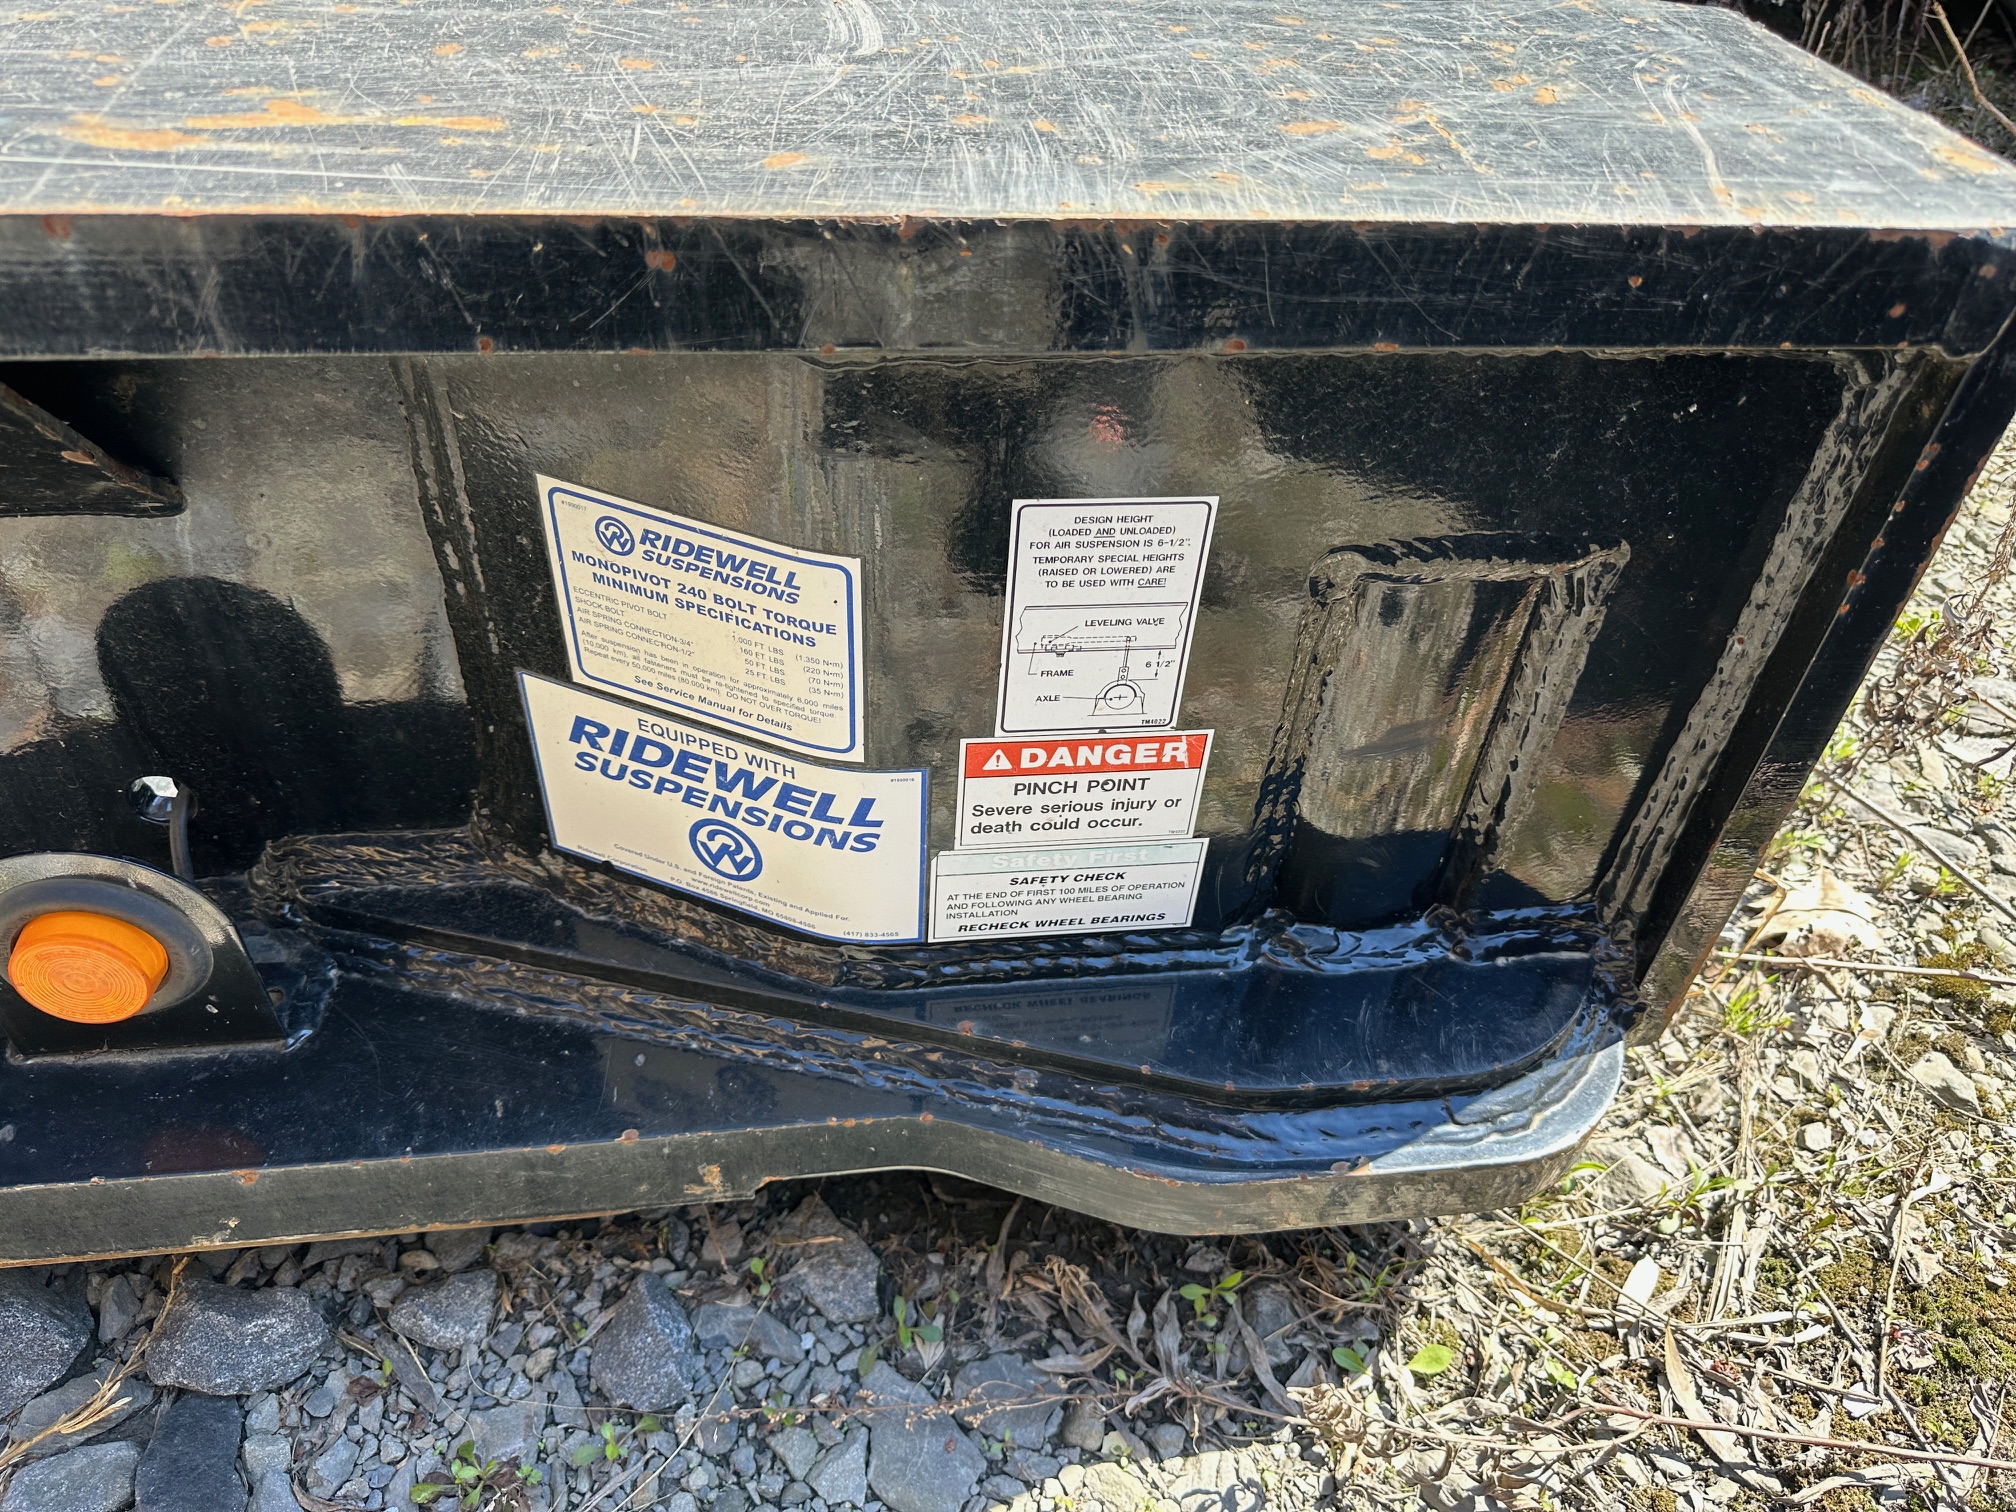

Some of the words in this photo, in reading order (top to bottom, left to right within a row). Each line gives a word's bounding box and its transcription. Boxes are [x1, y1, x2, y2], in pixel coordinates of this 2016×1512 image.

[1074, 516, 1113, 524] DESIGN
[1117, 515, 1153, 523] HEIGHT
[1049, 528, 1091, 537] (LOADED
[1095, 528, 1115, 536] AND
[1120, 527, 1175, 535] UNLOADED)
[1054, 541, 1071, 549] AIR
[1075, 539, 1139, 548] SUSPENSION
[1143, 539, 1153, 547] IS
[639, 528, 801, 591] RIDEWELL
[1033, 556, 1094, 564] TEMPORARY
[1098, 555, 1138, 563] SPECIAL
[1143, 553, 1184, 561] HEIGHTS
[641, 549, 800, 604] SUSPENSIONS
[1038, 568, 1078, 576] (RAISED
[1101, 566, 1152, 575] LOWERED)
[572, 550, 671, 589] MONOPIVOT
[677, 582, 706, 600] 240
[713, 592, 757, 616] BOLT
[762, 608, 837, 635] TORQUE
[1046, 580, 1058, 588] TO
[1079, 579, 1105, 587] USED
[1110, 578, 1134, 586] WITH
[1138, 578, 1166, 586] CARE!
[573, 586, 619, 605] ECCENTRIC
[621, 601, 645, 613] PIVOT
[647, 609, 667, 620] BOLT
[575, 597, 603, 610] SHOCK
[605, 606, 625, 616] BOLT
[592, 572, 669, 604] MINIMUM
[675, 598, 816, 647] SPECIFICATIONS
[577, 607, 590, 615] AIR
[592, 611, 622, 625] SPRING
[1085, 619, 1132, 627] LEVELING
[1136, 617, 1164, 625] VALVE
[579, 617, 591, 625] AIR
[594, 621, 624, 635] SPRING
[582, 630, 597, 640] After
[601, 638, 640, 654] suspension
[644, 649, 657, 659] has
[661, 655, 678, 665] been
[693, 666, 726, 680] operation
[744, 682, 793, 701] approximately
[823, 703, 843, 711] miles
[745, 658, 753, 666] 50
[803, 666, 820, 674] (220
[584, 647, 609, 660] Repeat
[611, 656, 630, 667] every
[658, 669, 675, 680] miles
[726, 691, 738, 700] DO
[741, 695, 757, 706] NOT
[759, 702, 782, 713] OVER
[784, 709, 821, 723] TORQUE!
[644, 658, 676, 672] fasteners
[681, 670, 698, 680] must
[702, 675, 711, 683] be
[773, 699, 805, 712] specified
[634, 675, 653, 687] See
[657, 682, 694, 700] Service
[698, 696, 736, 713] Manual
[739, 708, 754, 718] for
[757, 715, 793, 731] Details
[637, 718, 738, 762] EQUIPPED
[744, 752, 796, 780] WITH
[1020, 742, 1187, 769] DANGER
[568, 715, 884, 828] RIDEWELL
[1014, 780, 1077, 796] PINCH
[1087, 777, 1150, 792] POINT
[574, 751, 882, 853] SUSPENSIONS
[972, 804, 1032, 817] Severe
[1040, 800, 1103, 813] serious
[1111, 797, 1156, 811] injury
[1164, 798, 1181, 807] or
[971, 820, 1021, 834] death
[1030, 818, 1079, 831] could
[1087, 817, 1142, 829] occur.
[992, 852, 1077, 869] Safety
[1089, 849, 1148, 865] First
[614, 844, 643, 857] Covered
[644, 854, 665, 864] Under
[667, 862, 682, 871] U.S.
[684, 868, 696, 876] and
[699, 872, 726, 885] Foreign
[759, 892, 788, 907] Existing
[789, 902, 803, 911] and
[804, 908, 833, 919] Applied
[836, 914, 850, 922] For.
[1010, 875, 1070, 886] SAFETY
[1074, 872, 1126, 882] CHECK
[686, 882, 700, 890] Box
[762, 907, 774, 915] MO
[962, 892, 983, 900] THE
[1078, 885, 1108, 894] MILES
[1128, 882, 1185, 892] OPERATION
[972, 900, 1032, 909] FOLLOWING
[1036, 898, 1056, 906] ANY
[1059, 896, 1094, 904] WHEEL
[1097, 893, 1142, 902] BEARING
[946, 909, 1018, 919] INSTALLATION
[958, 921, 1029, 932] RECHECK
[1035, 918, 1085, 929] WHEEL
[1090, 913, 1166, 923] BEARINGS
